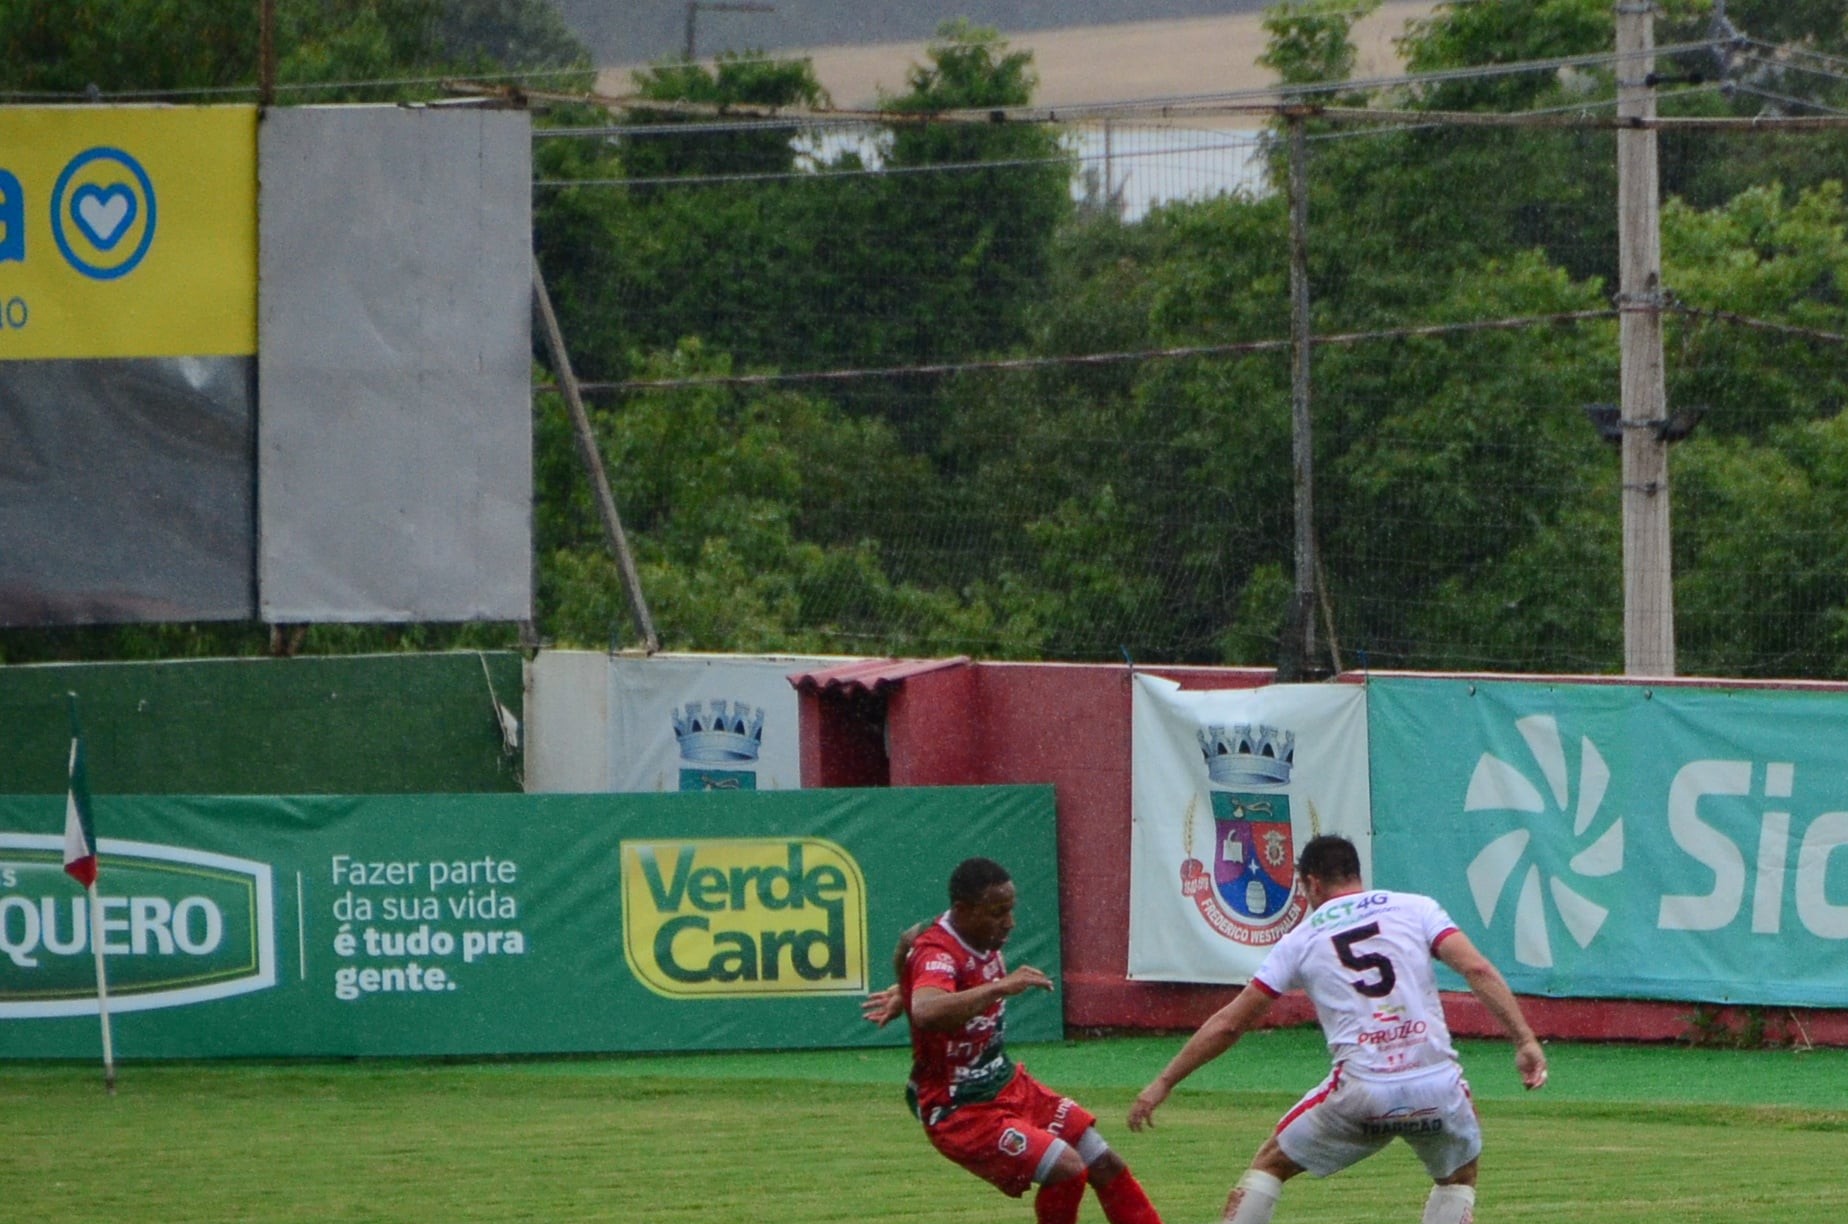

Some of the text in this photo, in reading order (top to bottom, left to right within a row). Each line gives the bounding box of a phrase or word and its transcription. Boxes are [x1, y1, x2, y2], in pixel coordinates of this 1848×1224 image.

[332, 855, 517, 892] Fazer parte
[634, 842, 848, 913] Verde
[333, 888, 516, 921] da sua vida
[1201, 898, 1249, 942] FREDERICO
[1250, 902, 1302, 944] WESTPHALEN
[1357, 892, 1389, 909] 4G
[0, 895, 223, 968] QUERO
[333, 923, 525, 963] é tudo pra
[653, 899, 848, 983] Card
[1330, 921, 1396, 997] 5
[335, 963, 457, 1001] gente.
